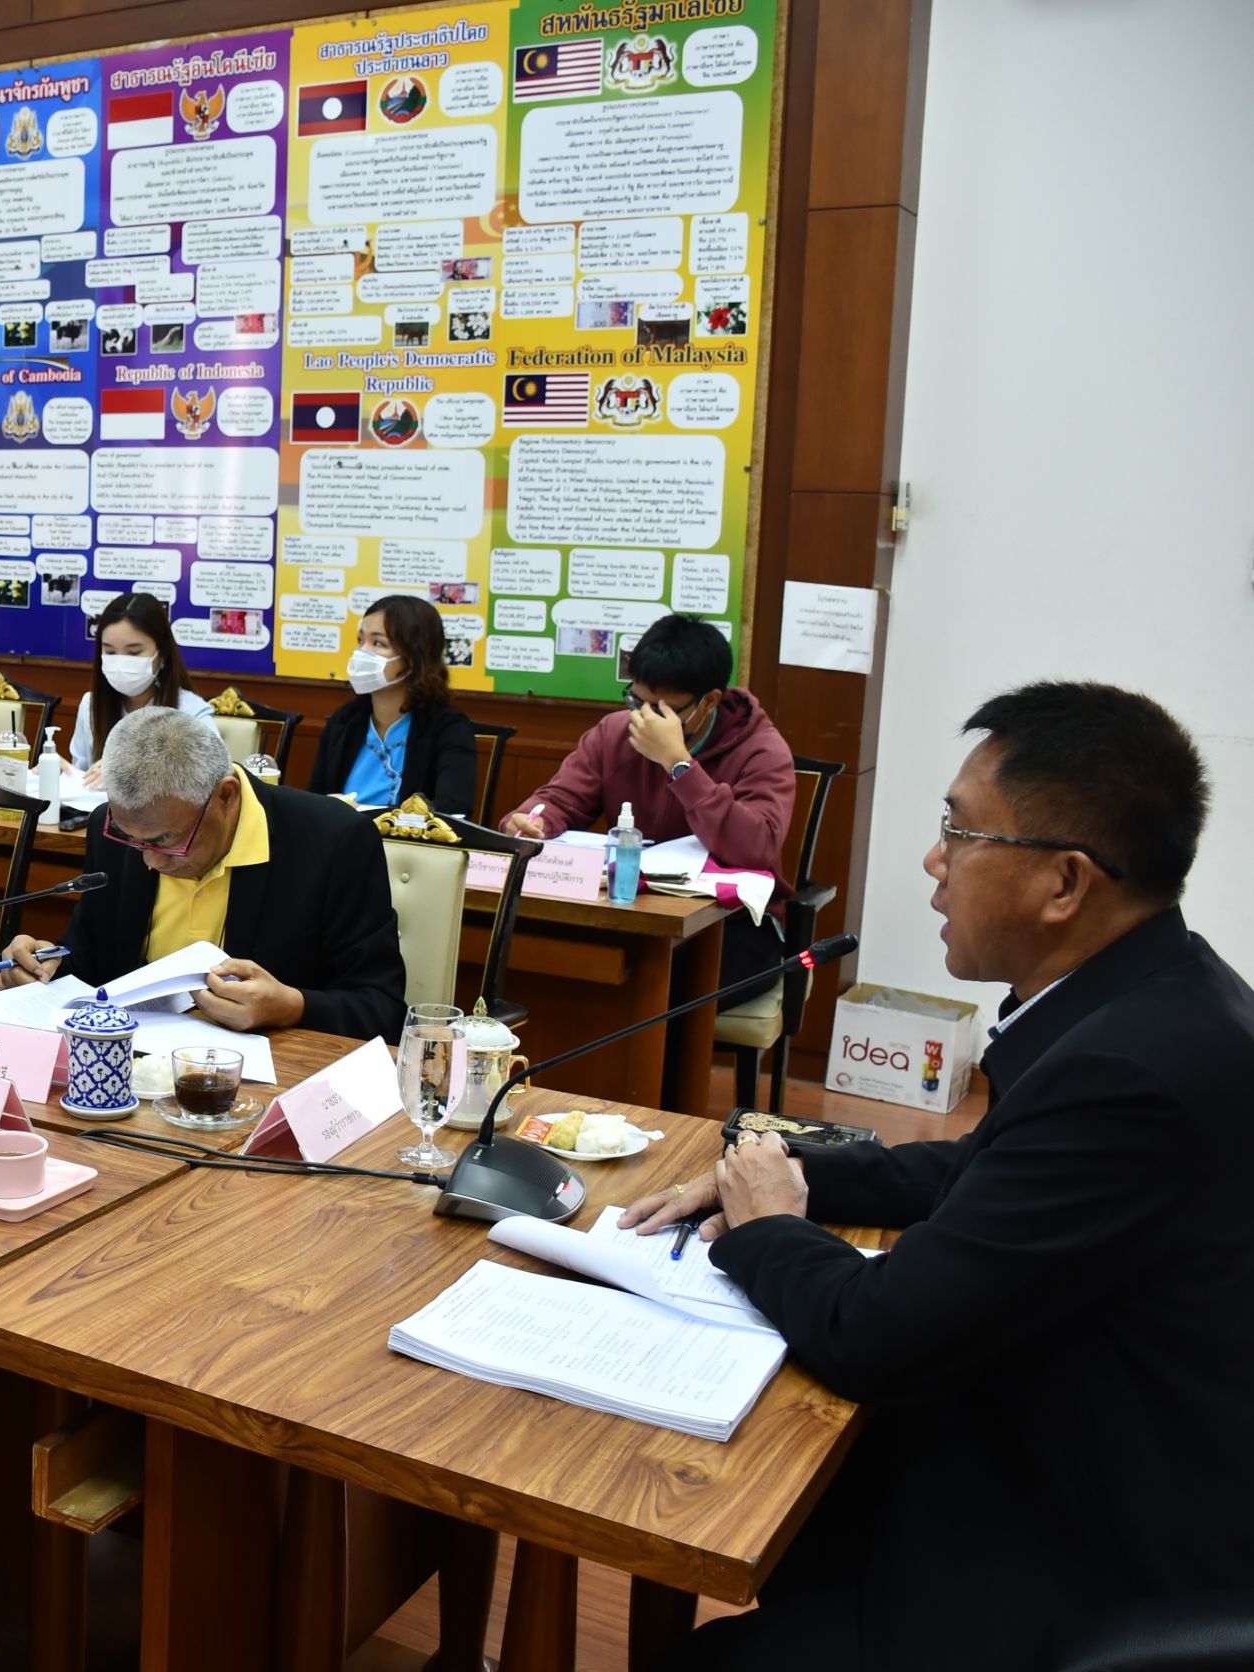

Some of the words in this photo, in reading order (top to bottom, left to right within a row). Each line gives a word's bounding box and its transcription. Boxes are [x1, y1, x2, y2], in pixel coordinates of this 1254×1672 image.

[541, 0, 743, 35] สหพันธรัฐมาเลเซย
[320, 20, 487, 59] สาธารณรัฐประชาธิปไตย
[111, 46, 276, 88] สาธารณรัฐอินโดนีเซีย
[355, 52, 448, 76] ประชาชนลาว
[304, 353, 332, 369] Lao
[337, 351, 399, 371] People's
[404, 349, 495, 367] Democratic
[508, 347, 615, 368] Federation
[622, 347, 642, 365] of
[650, 343, 746, 369] Malaysia
[2, 370, 15, 384] of
[18, 368, 82, 384] Cambodia
[116, 364, 174, 384] Republic
[179, 364, 194, 380] of
[198, 362, 264, 380] Indonesia
[365, 376, 434, 396] Republic
[843, 1035, 909, 1072] idea
